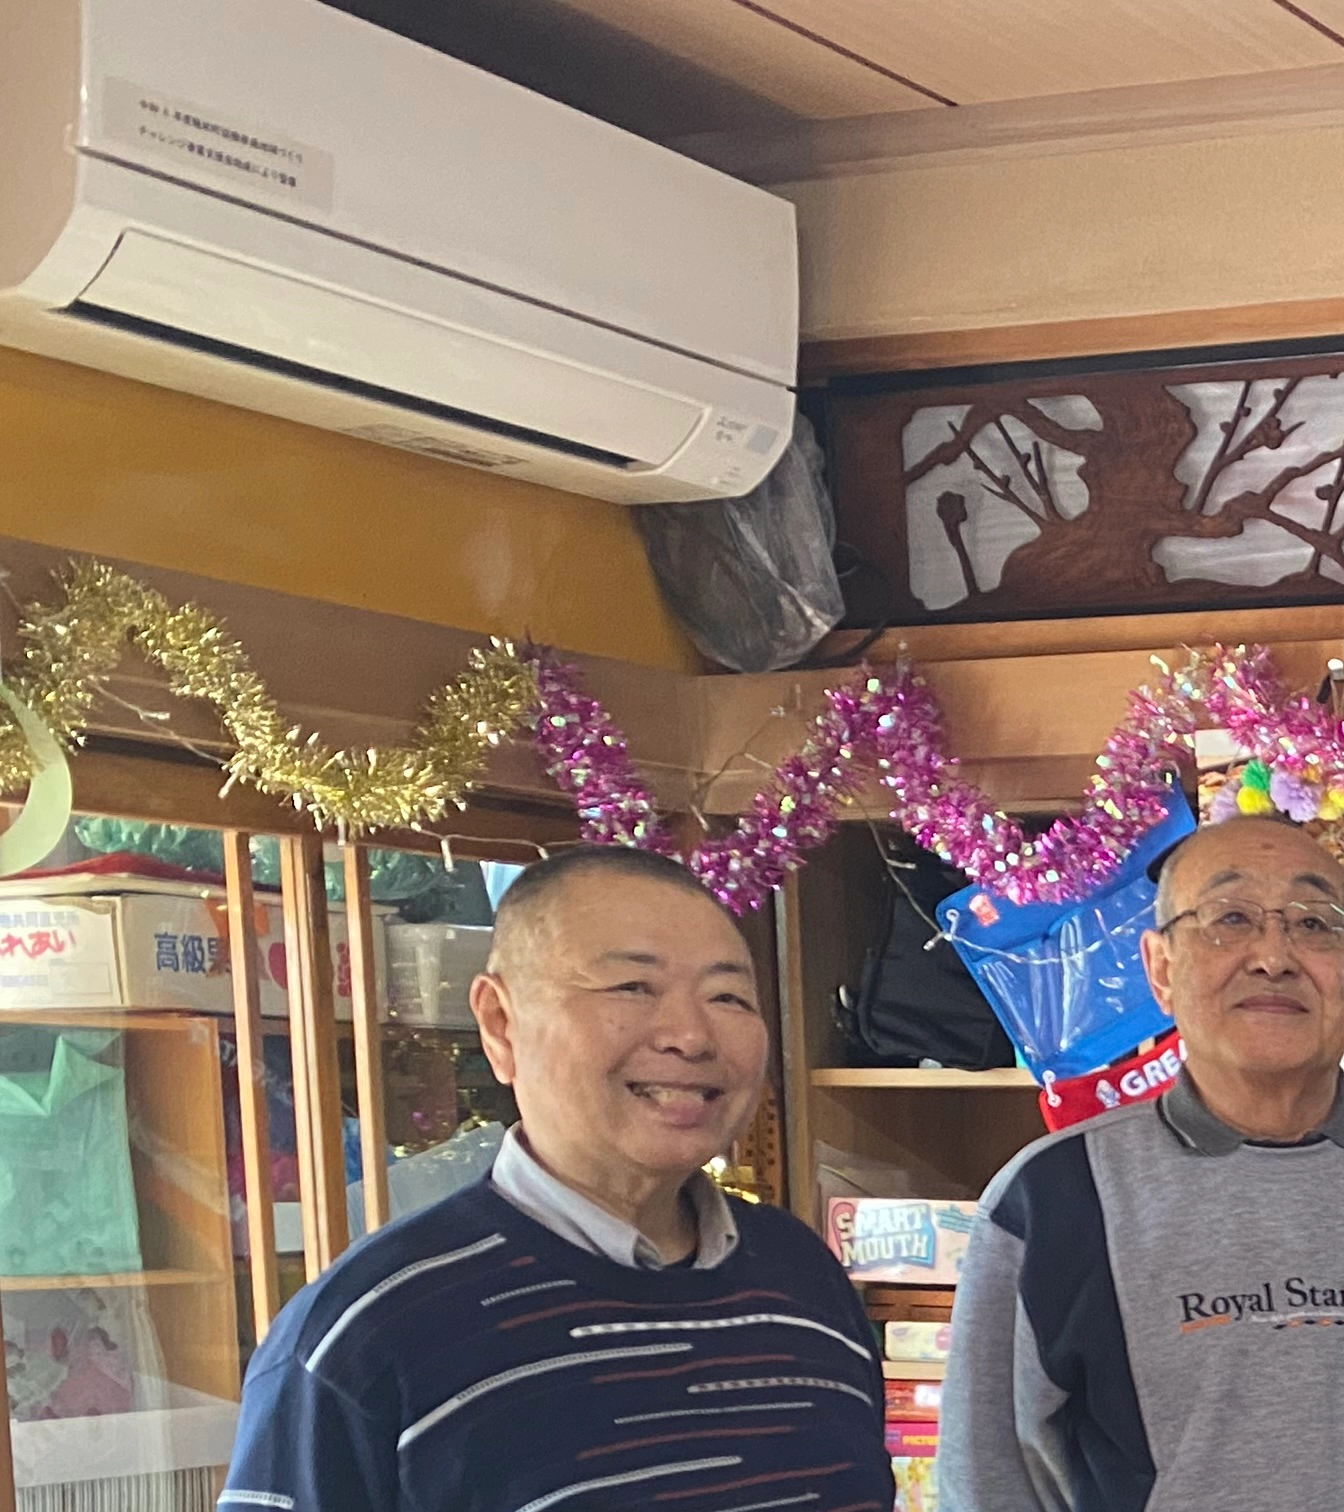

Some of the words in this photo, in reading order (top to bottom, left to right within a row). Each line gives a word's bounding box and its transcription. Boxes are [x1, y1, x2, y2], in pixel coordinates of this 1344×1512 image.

[1120, 1038, 1188, 1097] GRE
[836, 1207, 928, 1240] SMART
[840, 1232, 929, 1267] MOUTH
[1177, 1282, 1276, 1322] Royal
